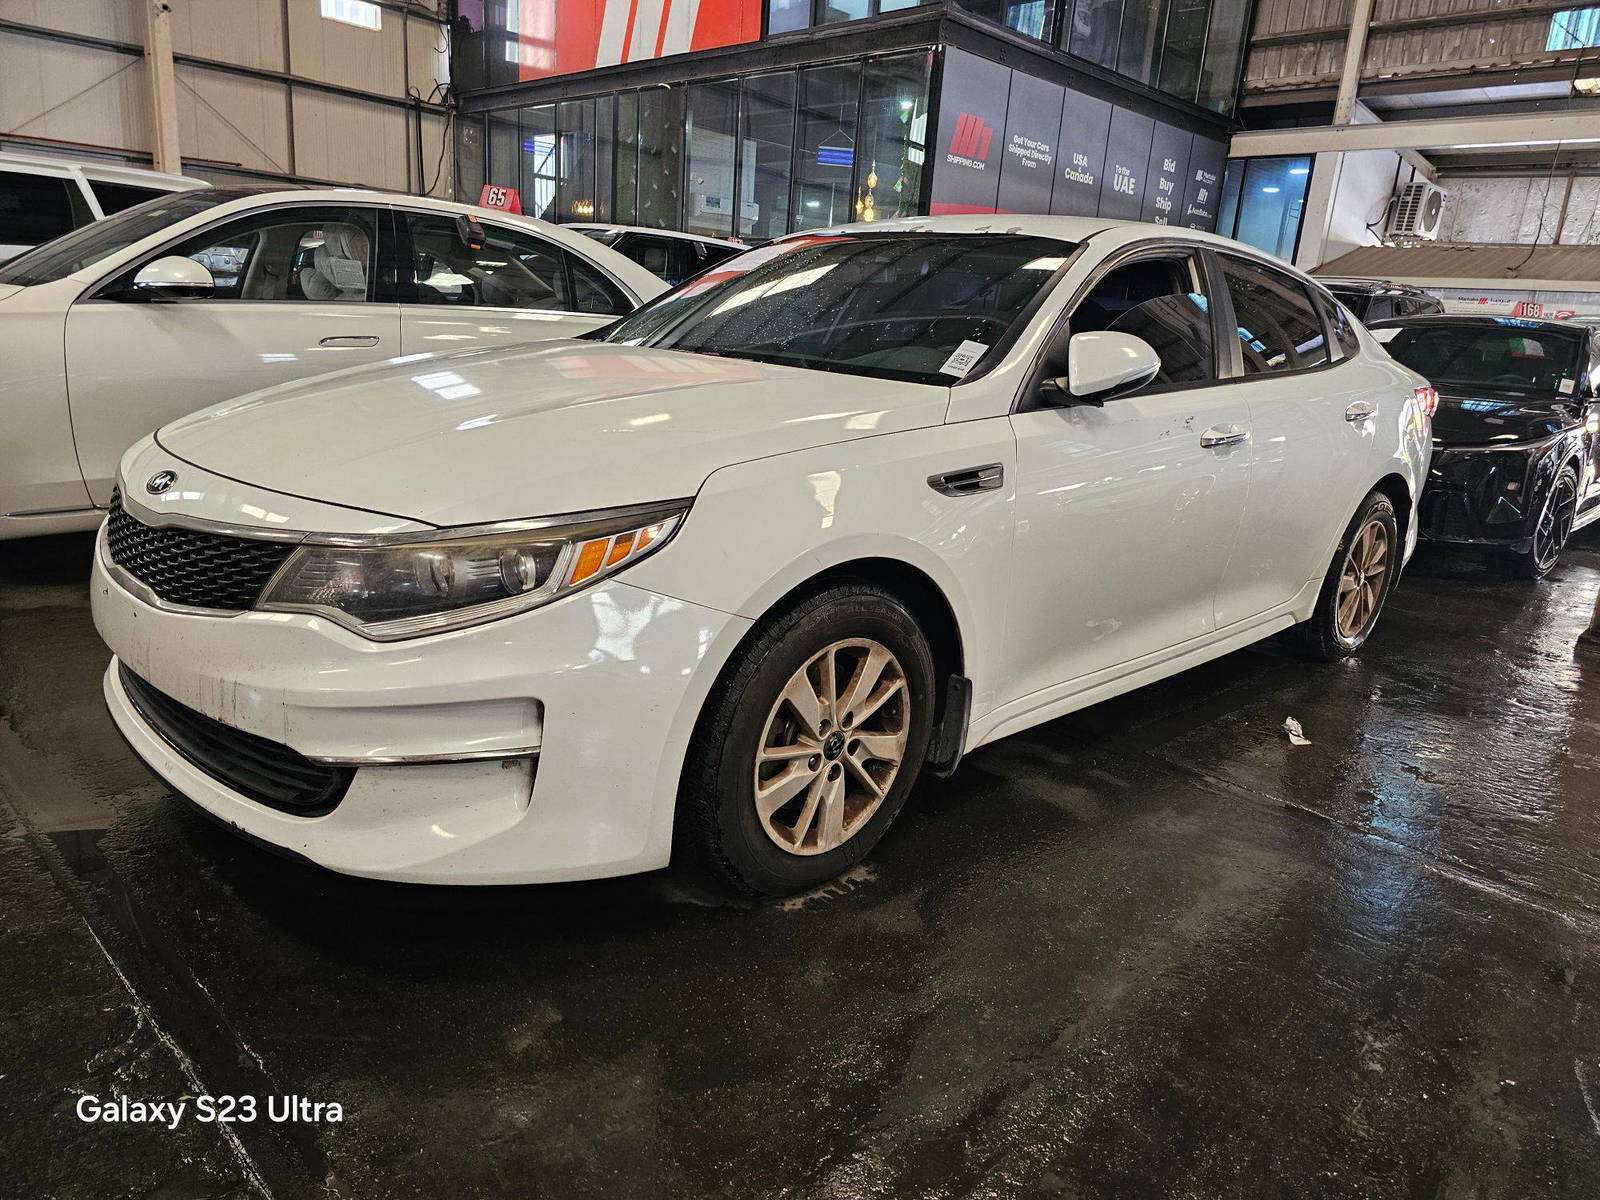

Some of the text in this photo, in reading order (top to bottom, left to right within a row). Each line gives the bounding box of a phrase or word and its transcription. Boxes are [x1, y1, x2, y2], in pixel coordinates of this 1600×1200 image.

[1013, 134, 1050, 152] Get Your Cars
[946, 154, 985, 170] SHIPPING.COM
[1008, 144, 1052, 164] Shipped Directly
[1073, 152, 1088, 167] USA
[1021, 158, 1037, 168] From
[1115, 164, 1130, 176] To the
[1163, 158, 1176, 172] Bid
[1064, 167, 1094, 184] Canada
[1113, 173, 1136, 195] UAE
[1159, 177, 1174, 196] Buy
[488, 187, 507, 207] 65
[1155, 196, 1172, 214] Ship
[1154, 215, 1168, 226] Sell
[1522, 302, 1540, 317] 168
